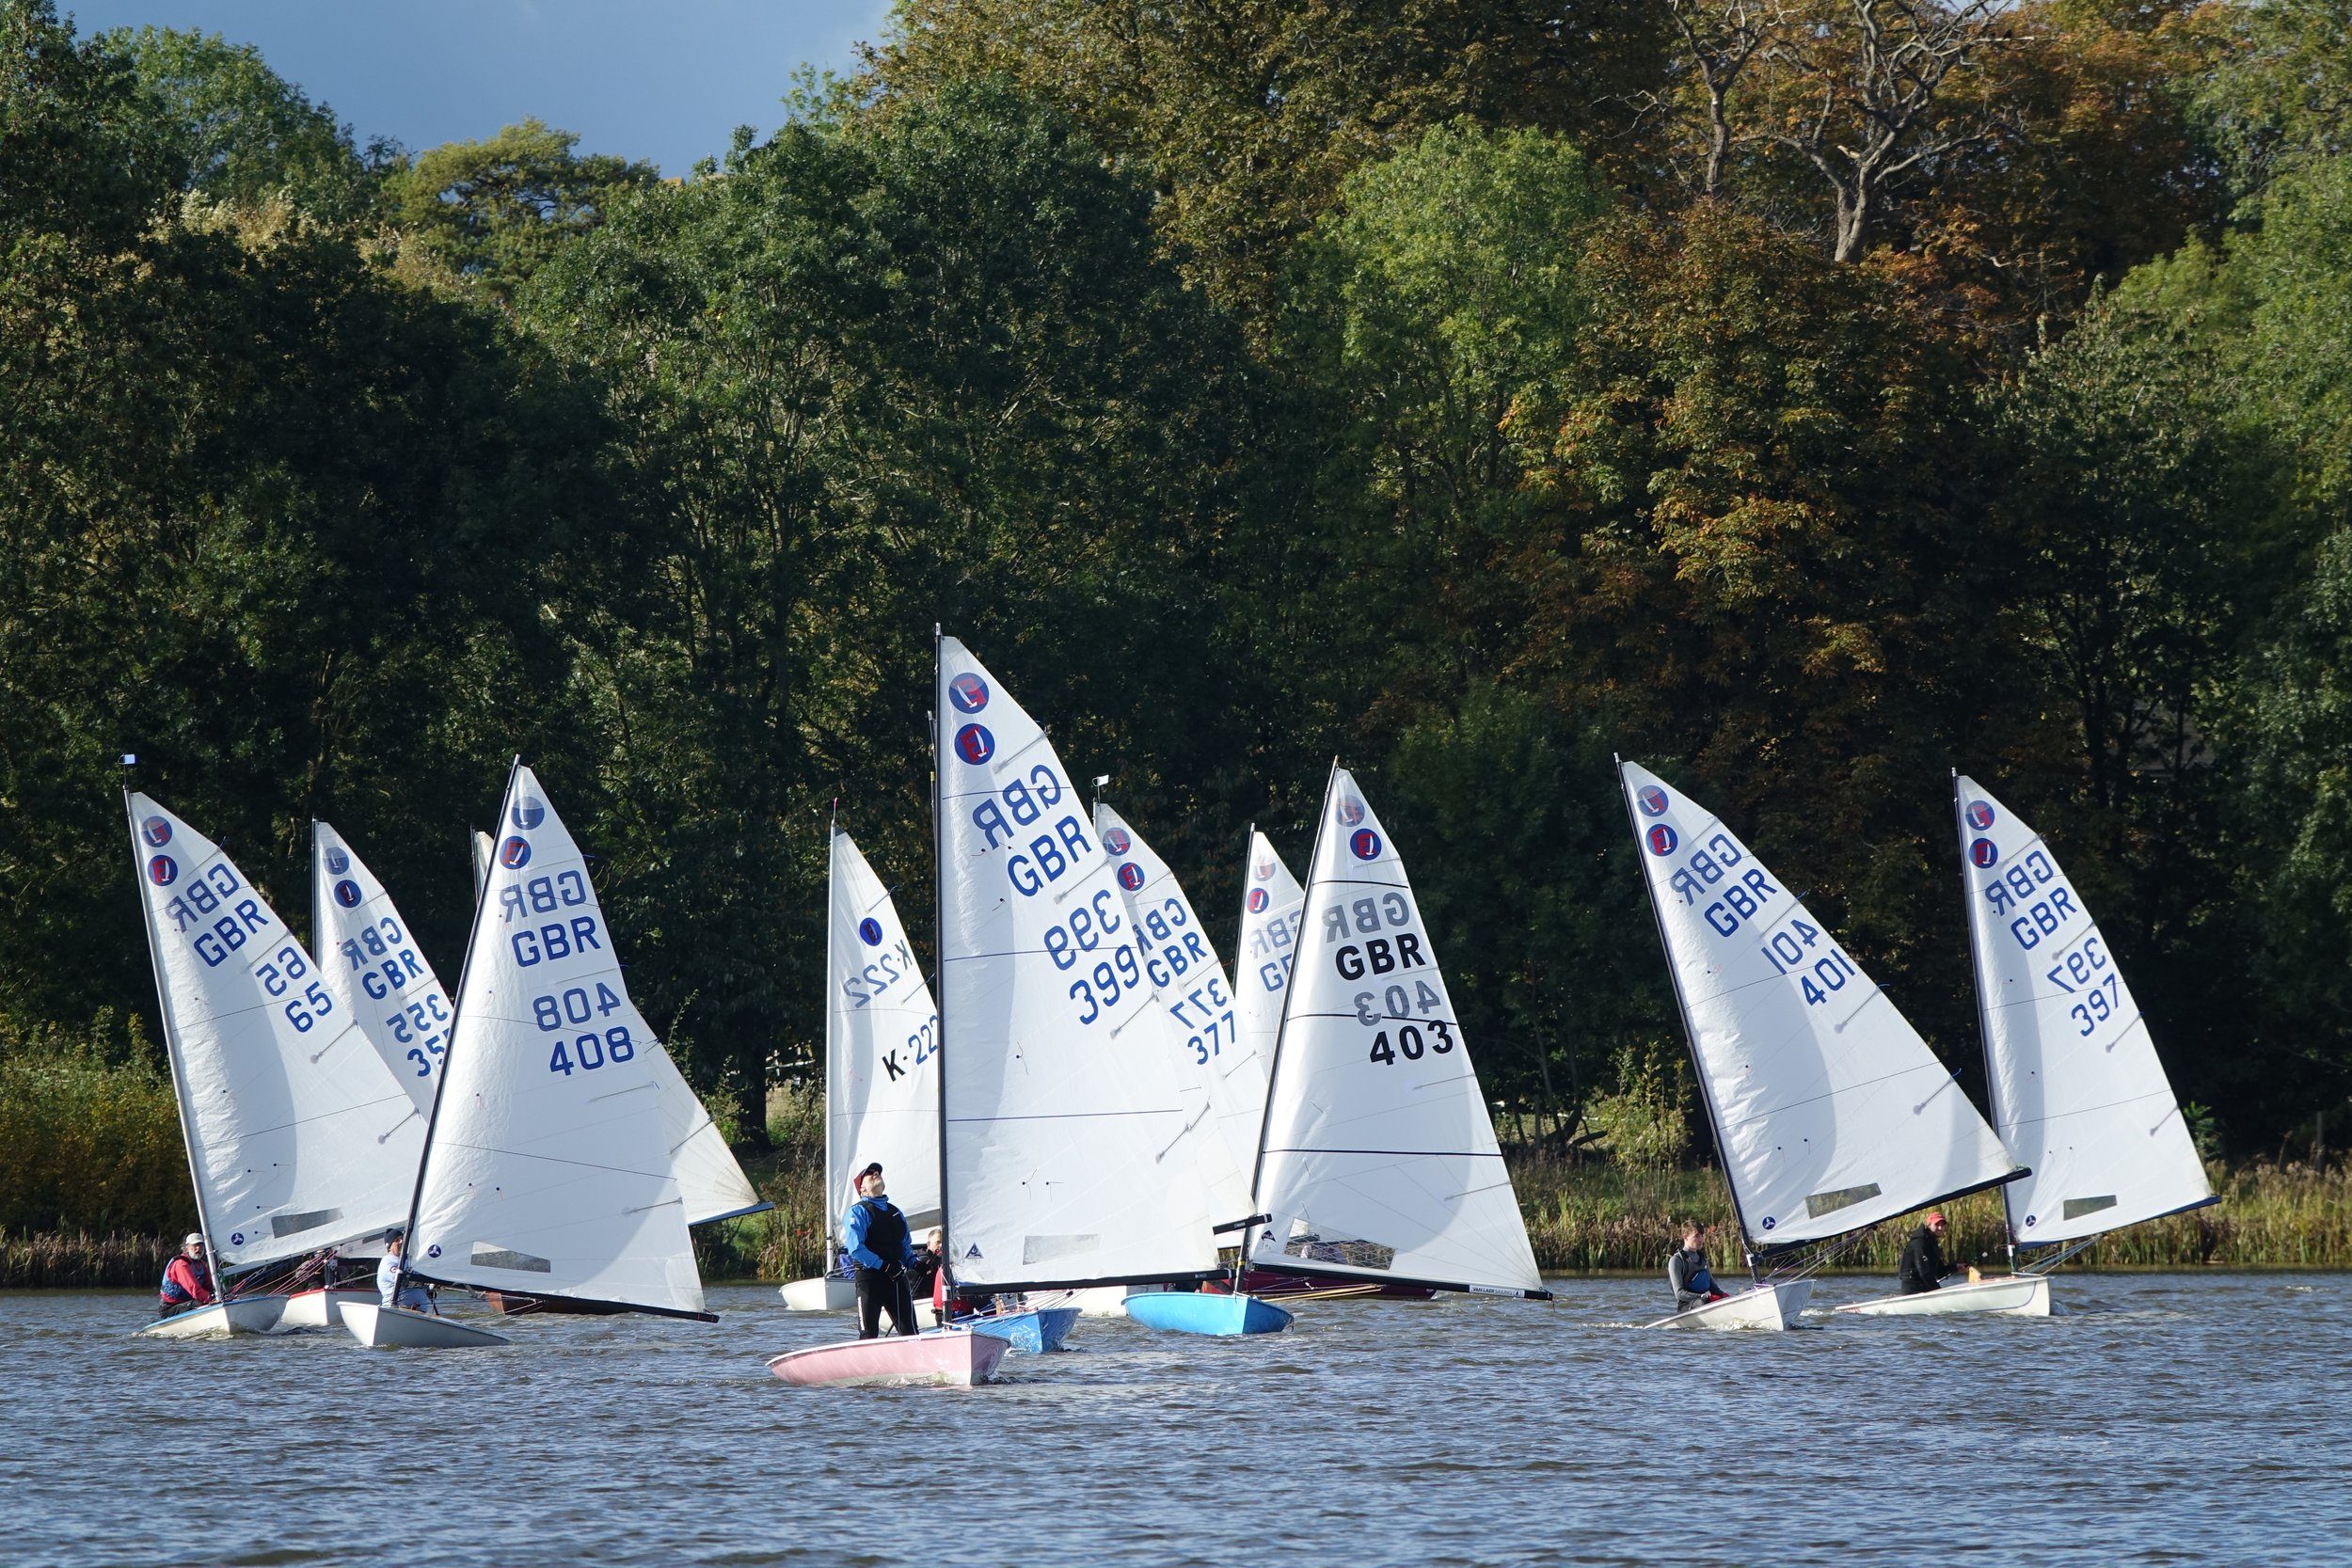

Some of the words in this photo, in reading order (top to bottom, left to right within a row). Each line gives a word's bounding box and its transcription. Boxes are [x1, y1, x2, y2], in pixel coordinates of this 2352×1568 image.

[1007, 815, 1092, 897] GBR
[1704, 868, 1777, 938] GBR
[2010, 886, 2077, 951] GBR
[193, 898, 269, 968] GBR
[511, 916, 601, 968] GBR
[1146, 931, 1208, 988] GBR
[1335, 932, 1426, 981] GBR
[361, 948, 424, 1000] GBR
[1070, 944, 1139, 1026] 399
[1801, 948, 1856, 1006] 401
[285, 981, 333, 1034] 65
[2071, 972, 2119, 1037] 397
[406, 1026, 450, 1078] 35
[549, 1025, 635, 1077] 408
[1187, 1009, 1236, 1067] 377
[1369, 1019, 1454, 1067] 403
